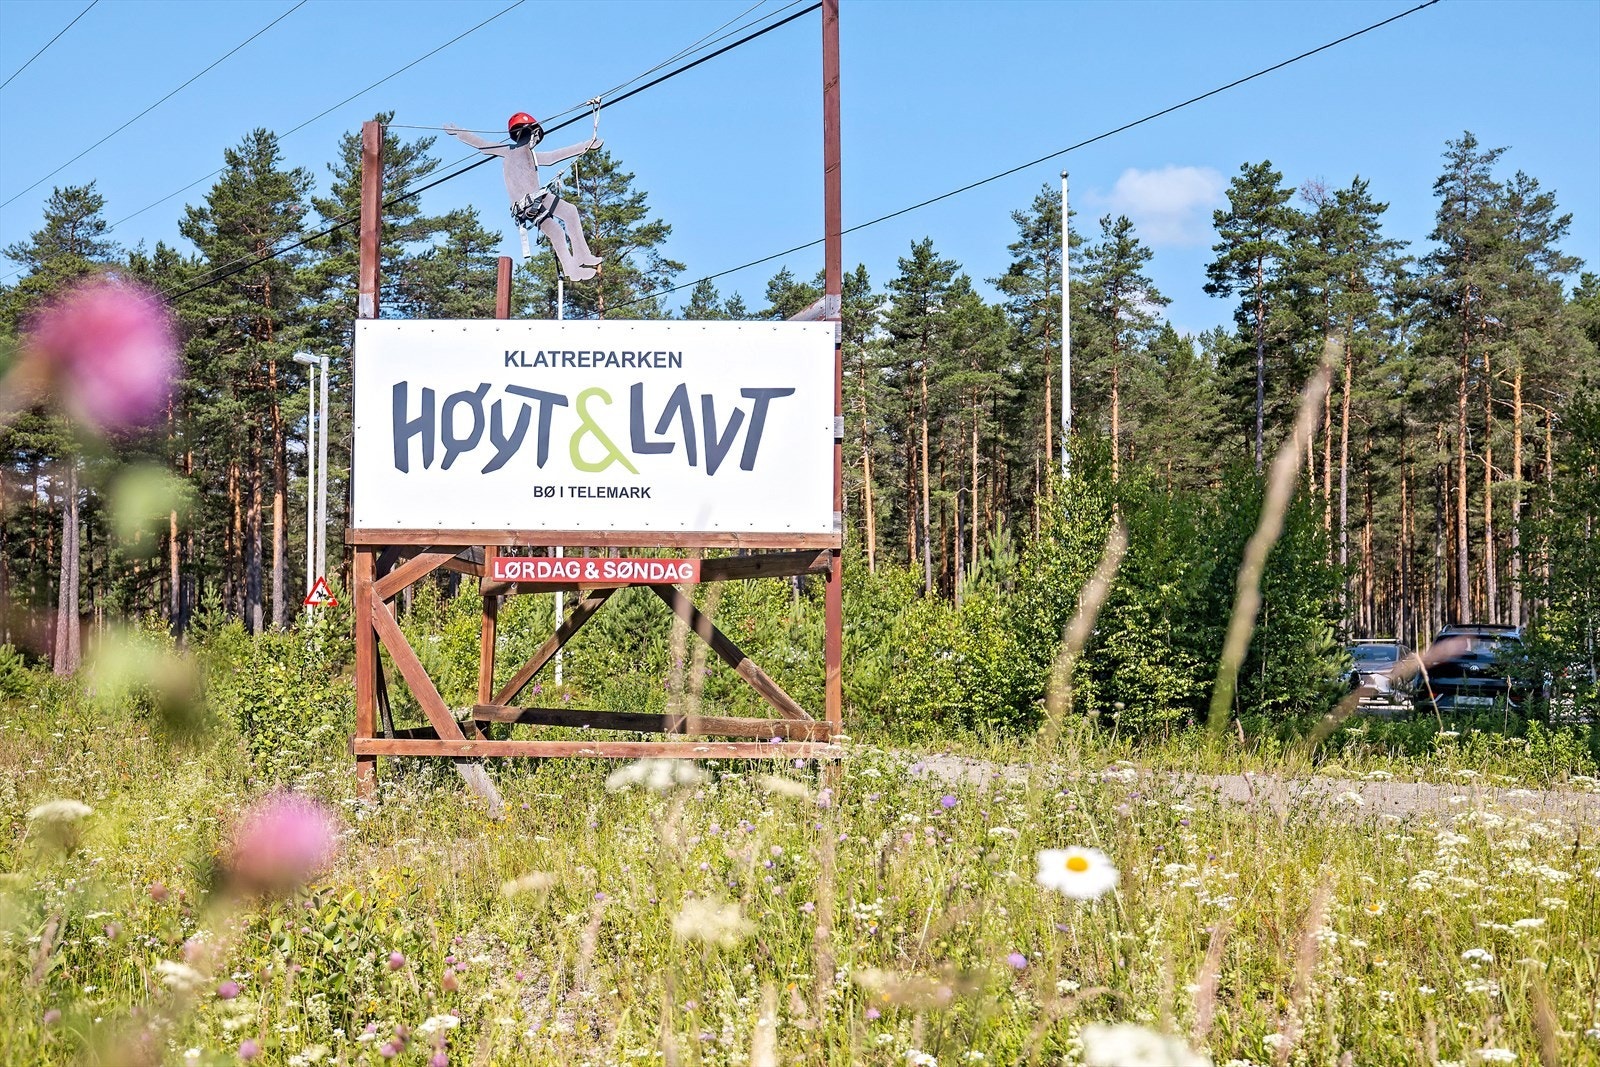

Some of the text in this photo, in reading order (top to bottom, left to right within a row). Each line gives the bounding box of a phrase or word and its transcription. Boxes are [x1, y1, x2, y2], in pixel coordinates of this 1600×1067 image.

[504, 350, 683, 369] KLATREPARKEN
[533, 485, 652, 499] BØ I TELEMARK
[494, 560, 693, 581] LØRDAG & SØNDAG
